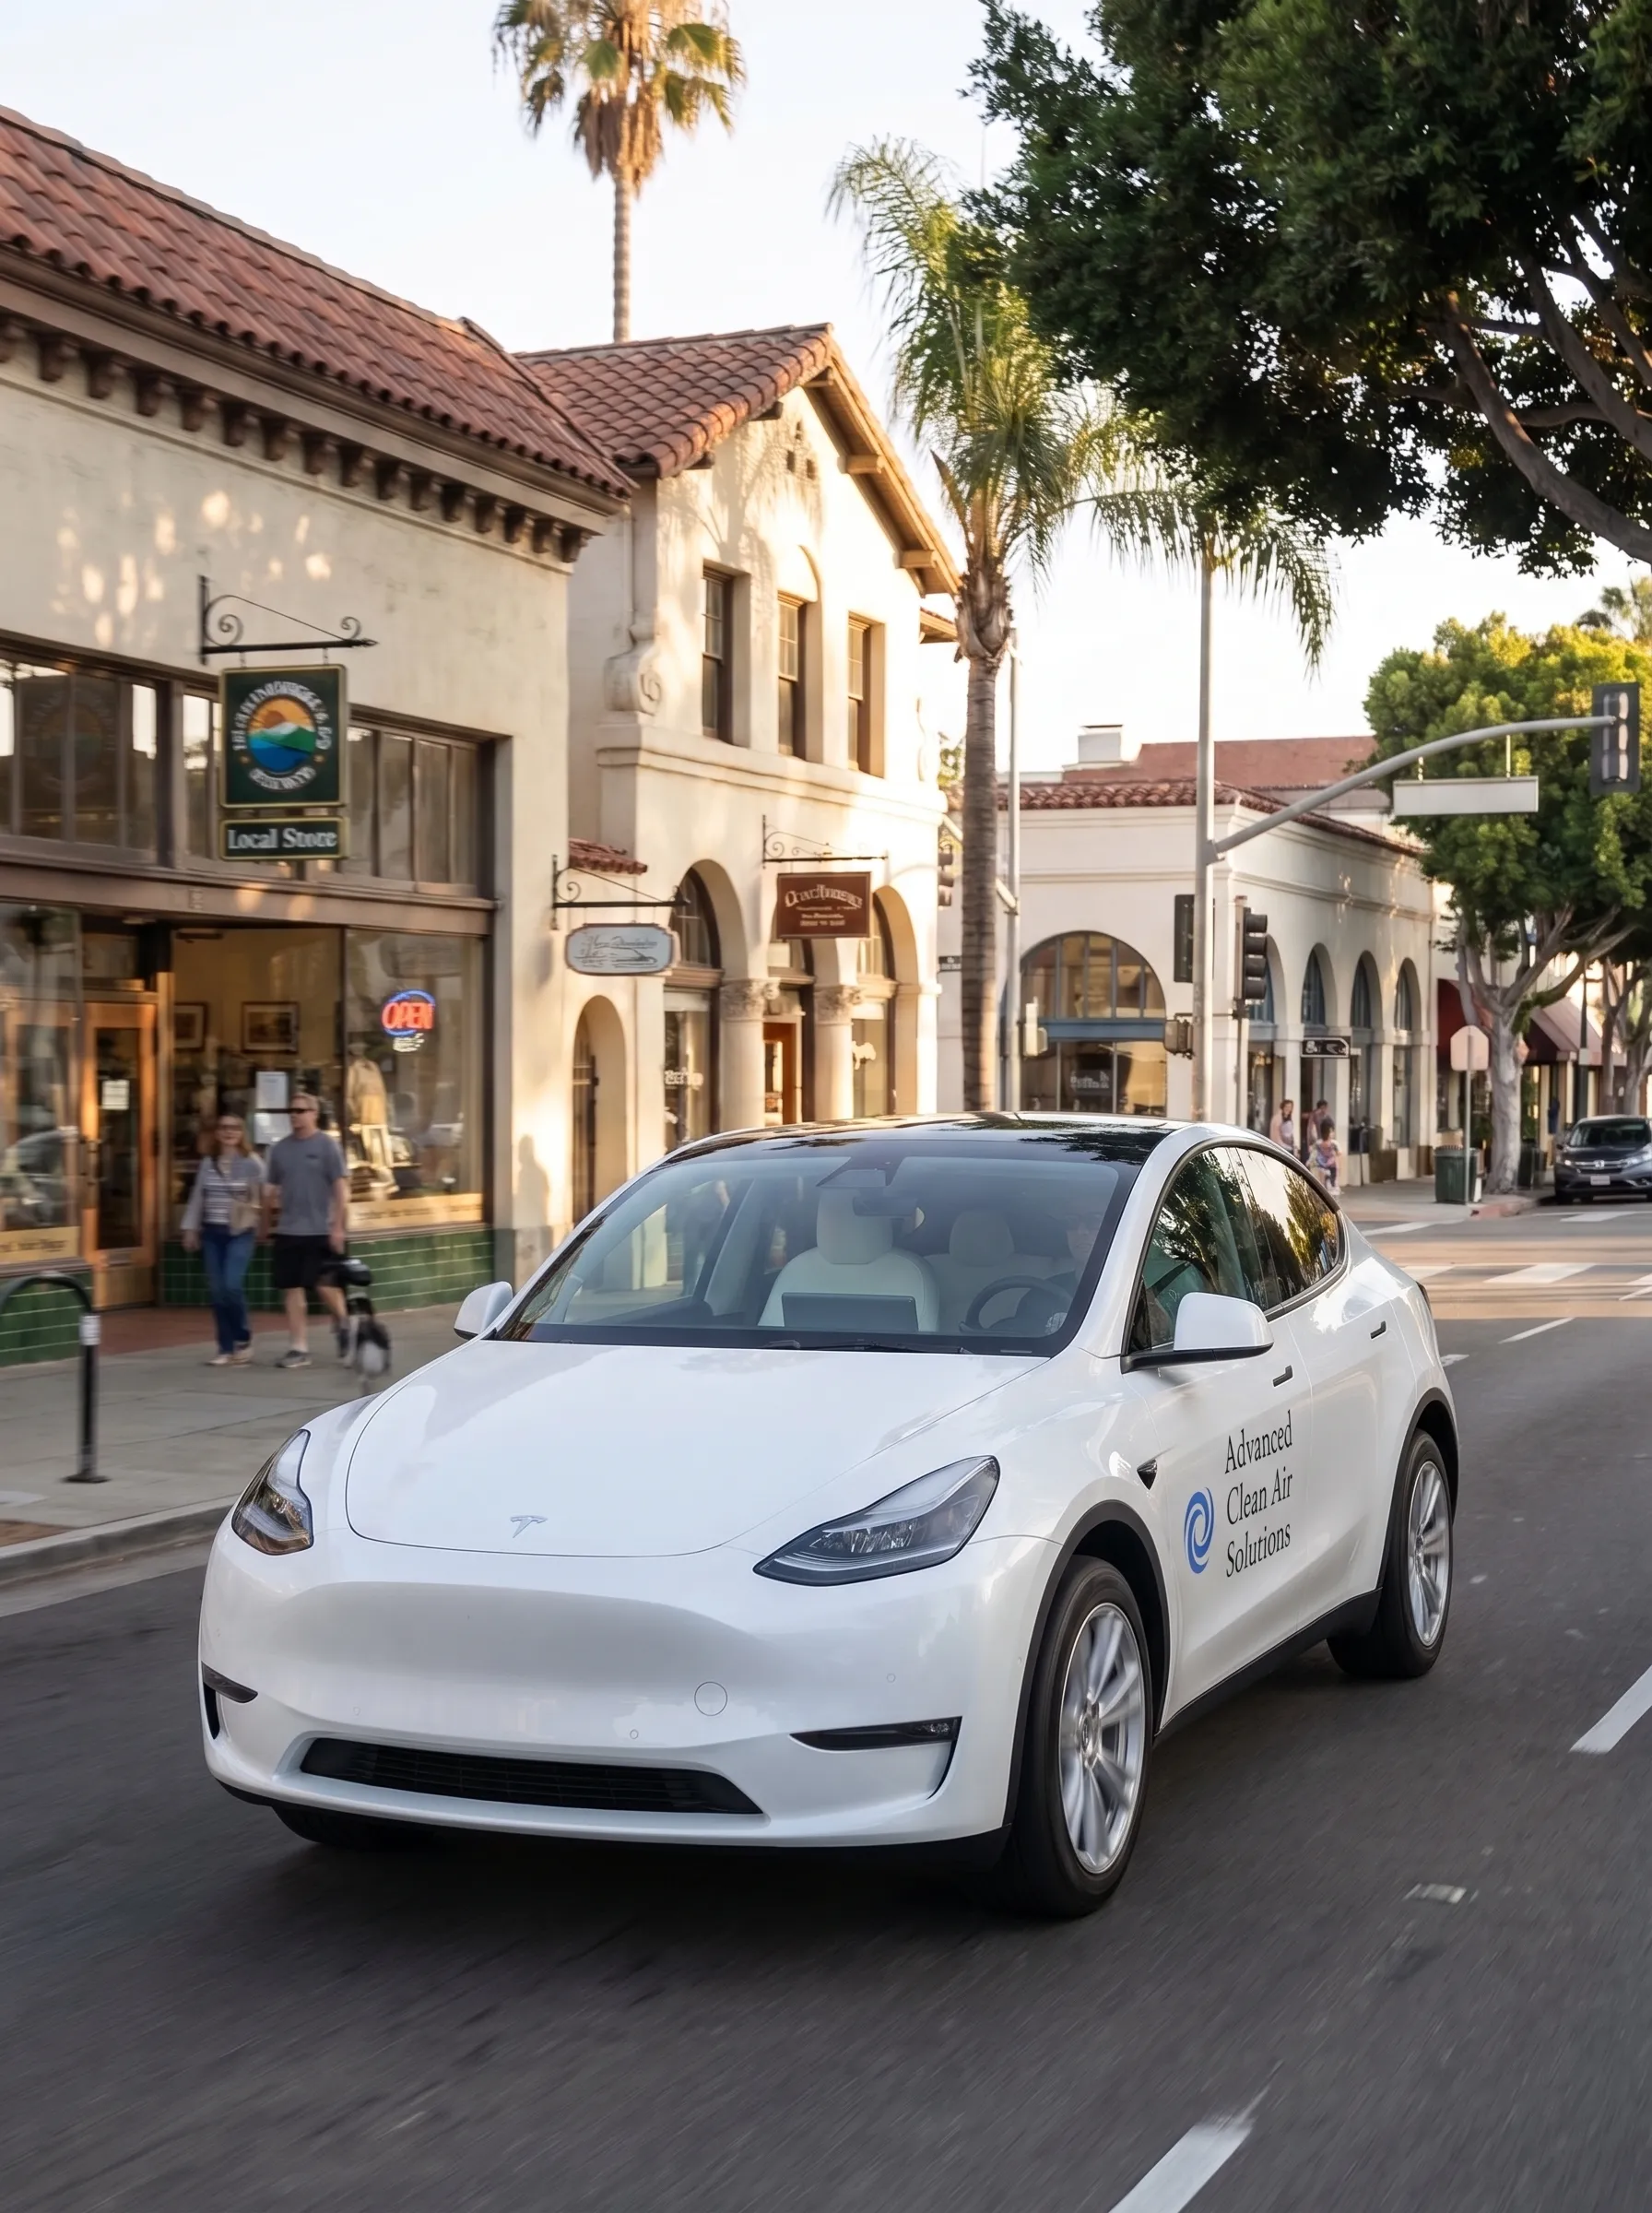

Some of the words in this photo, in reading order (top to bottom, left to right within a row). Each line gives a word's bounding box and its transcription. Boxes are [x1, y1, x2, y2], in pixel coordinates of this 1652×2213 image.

[228, 830, 278, 849] Local
[382, 1002, 433, 1029] OPEN
[1224, 1409, 1293, 1474] Advanced
[1226, 1482, 1268, 1525] Clean
[1270, 1466, 1293, 1506] Air
[1225, 1523, 1291, 1578] Solutions
